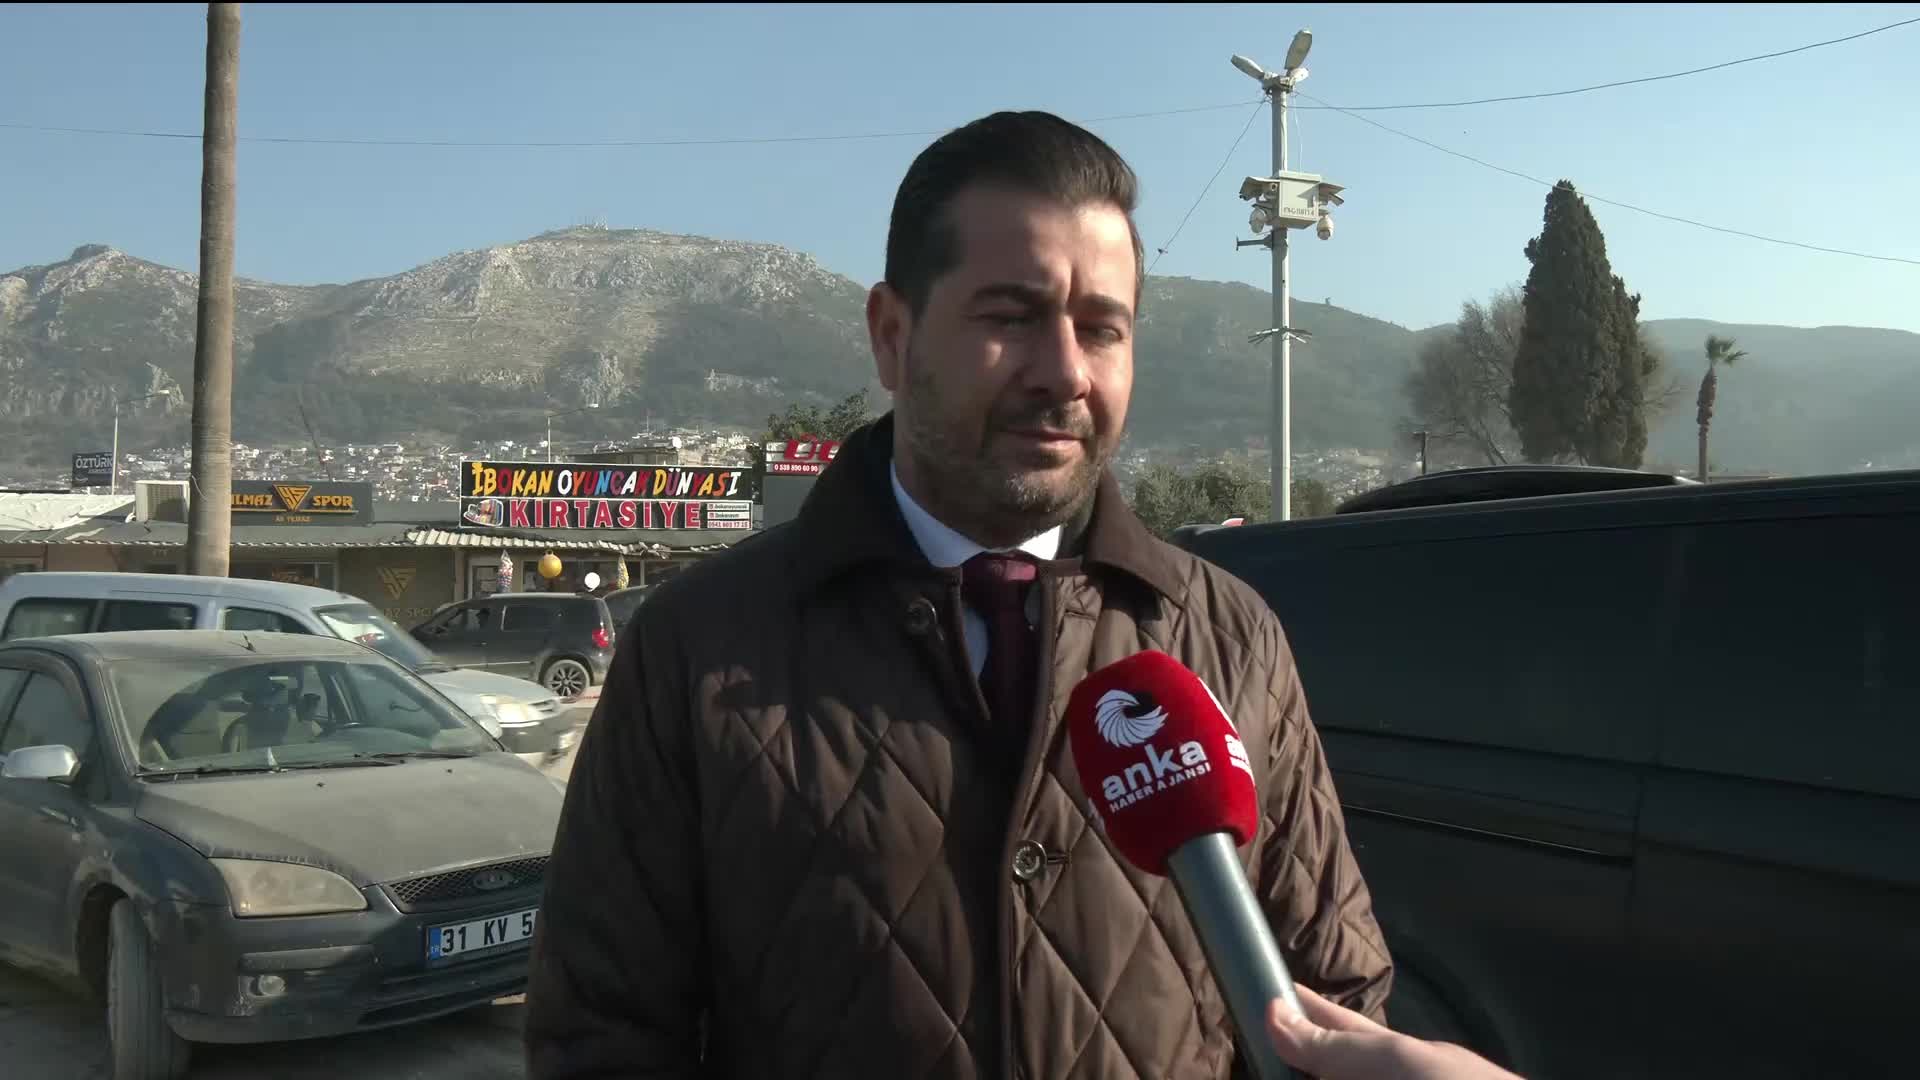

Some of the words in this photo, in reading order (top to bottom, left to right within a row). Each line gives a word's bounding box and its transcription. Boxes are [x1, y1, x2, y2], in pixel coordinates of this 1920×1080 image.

[75, 455, 112, 469] ÖZTÜRK
[472, 462, 554, 496] İBOKAN
[558, 469, 652, 496] OYUNCAK
[652, 468, 742, 496] DÜNYASI
[313, 495, 353, 507] SPOR
[509, 499, 701, 528] KIRTASİYE
[1102, 740, 1208, 801] anka
[1109, 785, 1154, 813] HABER
[441, 926, 467, 953] 31
[484, 917, 508, 946] KV
[522, 912, 533, 937] 5
